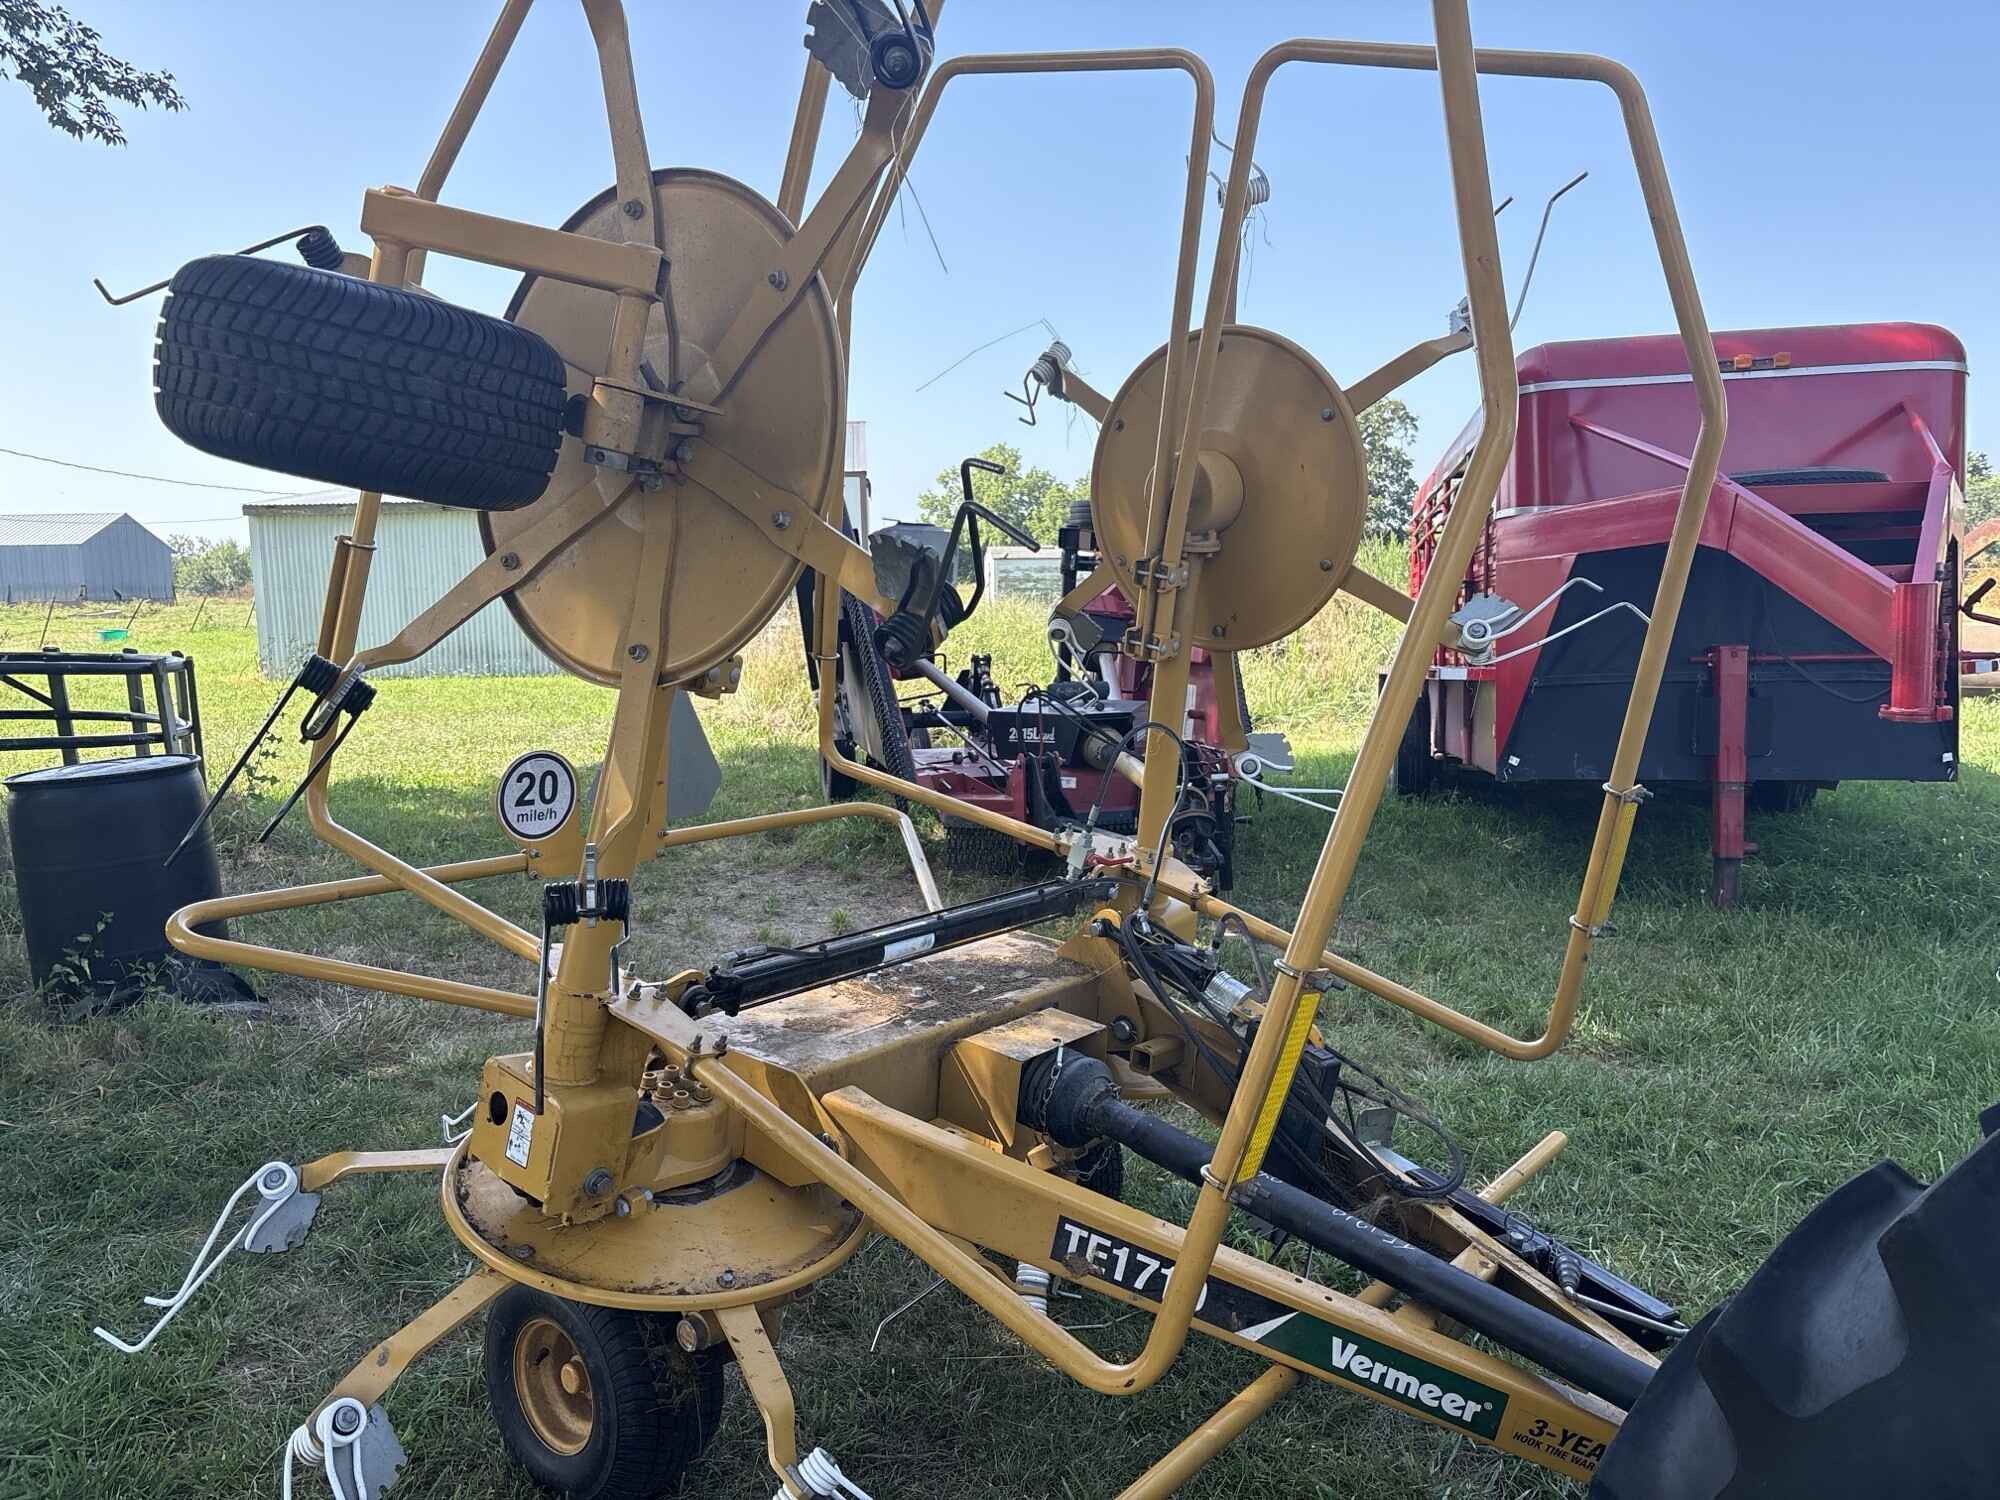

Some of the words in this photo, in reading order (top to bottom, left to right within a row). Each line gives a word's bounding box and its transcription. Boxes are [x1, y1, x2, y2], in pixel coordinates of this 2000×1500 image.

[514, 770, 559, 807] 20
[517, 808, 557, 823] mile/h
[1064, 1222, 1208, 1312] TE17
[1512, 1431, 1543, 1450] HOOK
[1546, 1444, 1569, 1461] TINE
